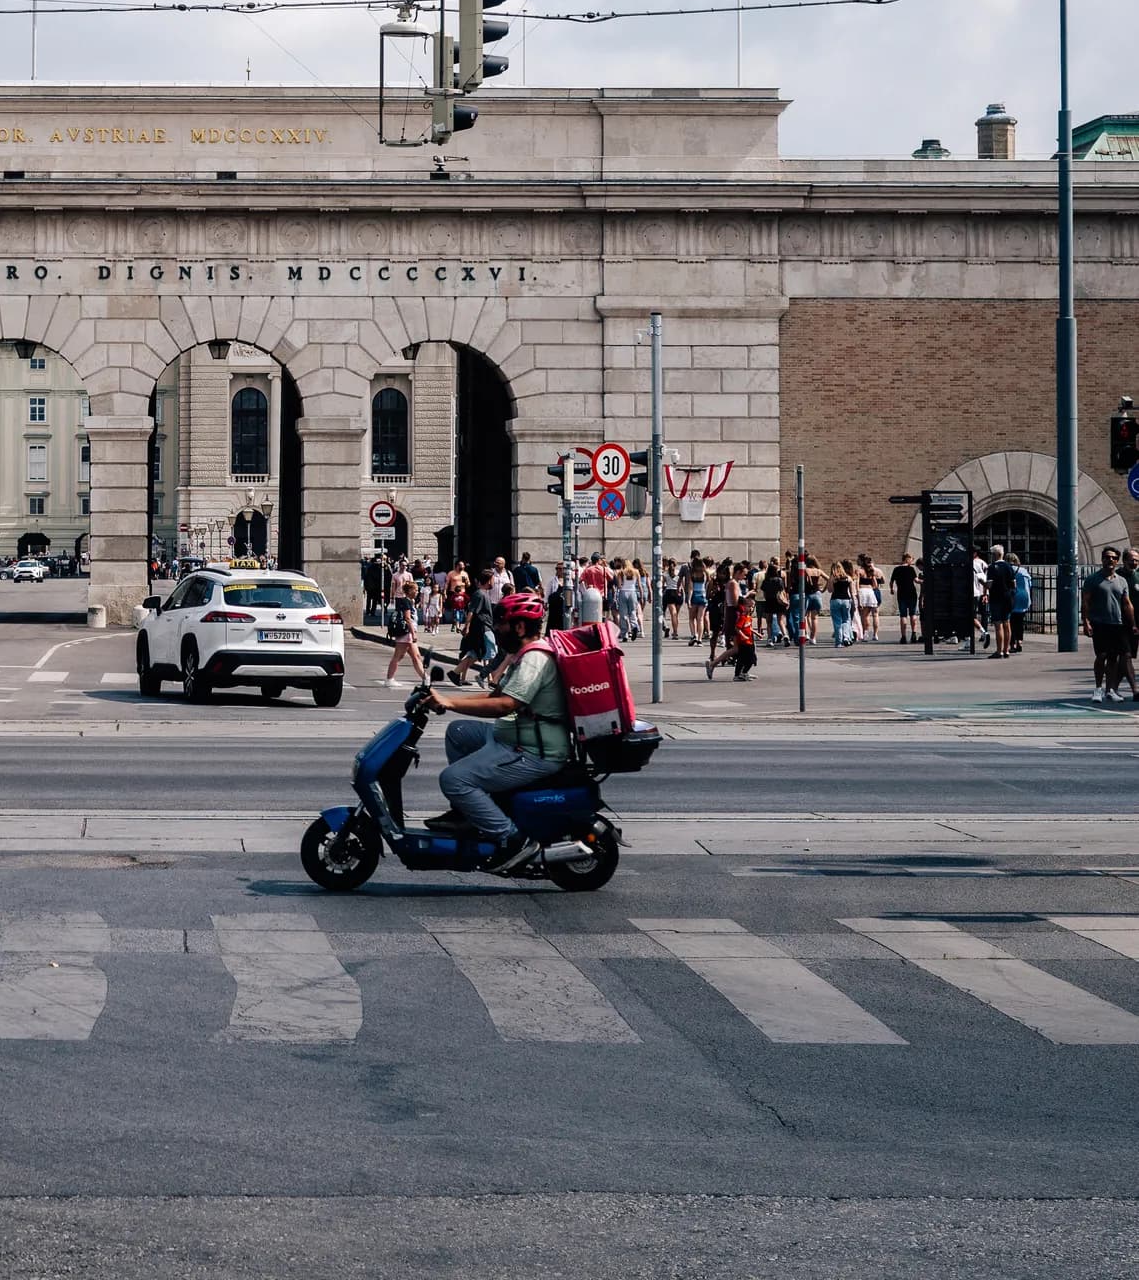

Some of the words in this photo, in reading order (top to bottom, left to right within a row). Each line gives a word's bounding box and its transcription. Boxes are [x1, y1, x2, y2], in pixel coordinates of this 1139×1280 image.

[98, 266, 253, 281] DIGNIS.
[288, 267, 537, 281] MDCCCCXVI.
[602, 456, 620, 475] 30
[236, 560, 255, 568] TAXI
[570, 682, 610, 694] foodora
